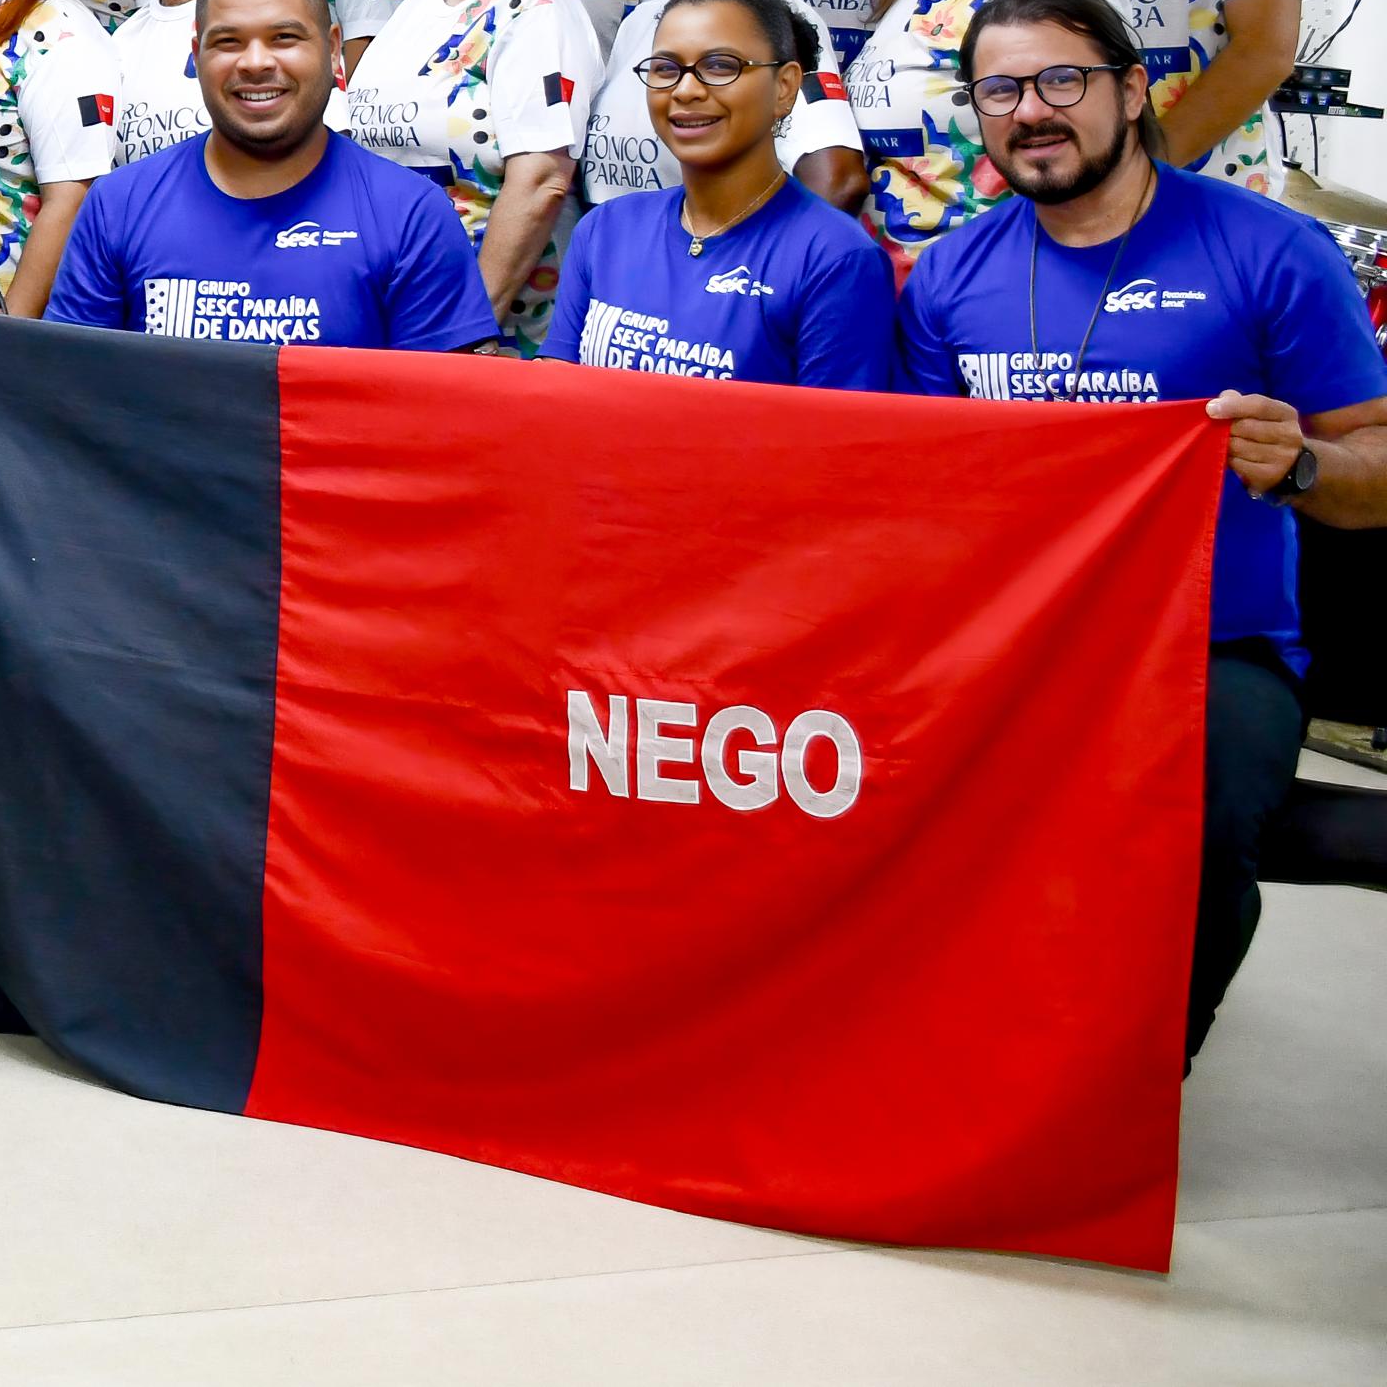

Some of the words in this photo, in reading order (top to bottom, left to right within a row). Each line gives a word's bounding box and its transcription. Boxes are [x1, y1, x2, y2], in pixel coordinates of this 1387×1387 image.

[121, 101, 149, 121] RO
[588, 114, 610, 132] RO
[198, 280, 251, 297] GRUPO
[195, 298, 239, 317] SESC
[242, 295, 320, 317] PARAÍBA
[1103, 291, 1158, 313] Sesc
[193, 318, 224, 340] DE
[619, 310, 670, 335] GRUPO
[607, 346, 635, 371] DE
[611, 326, 656, 353] SESC
[655, 342, 735, 371] PARAÍBA
[1009, 352, 1073, 371] GRUPO
[1010, 372, 1060, 395] SESC
[1064, 369, 1159, 394] PARAÍBA
[567, 689, 863, 820] NEGO
